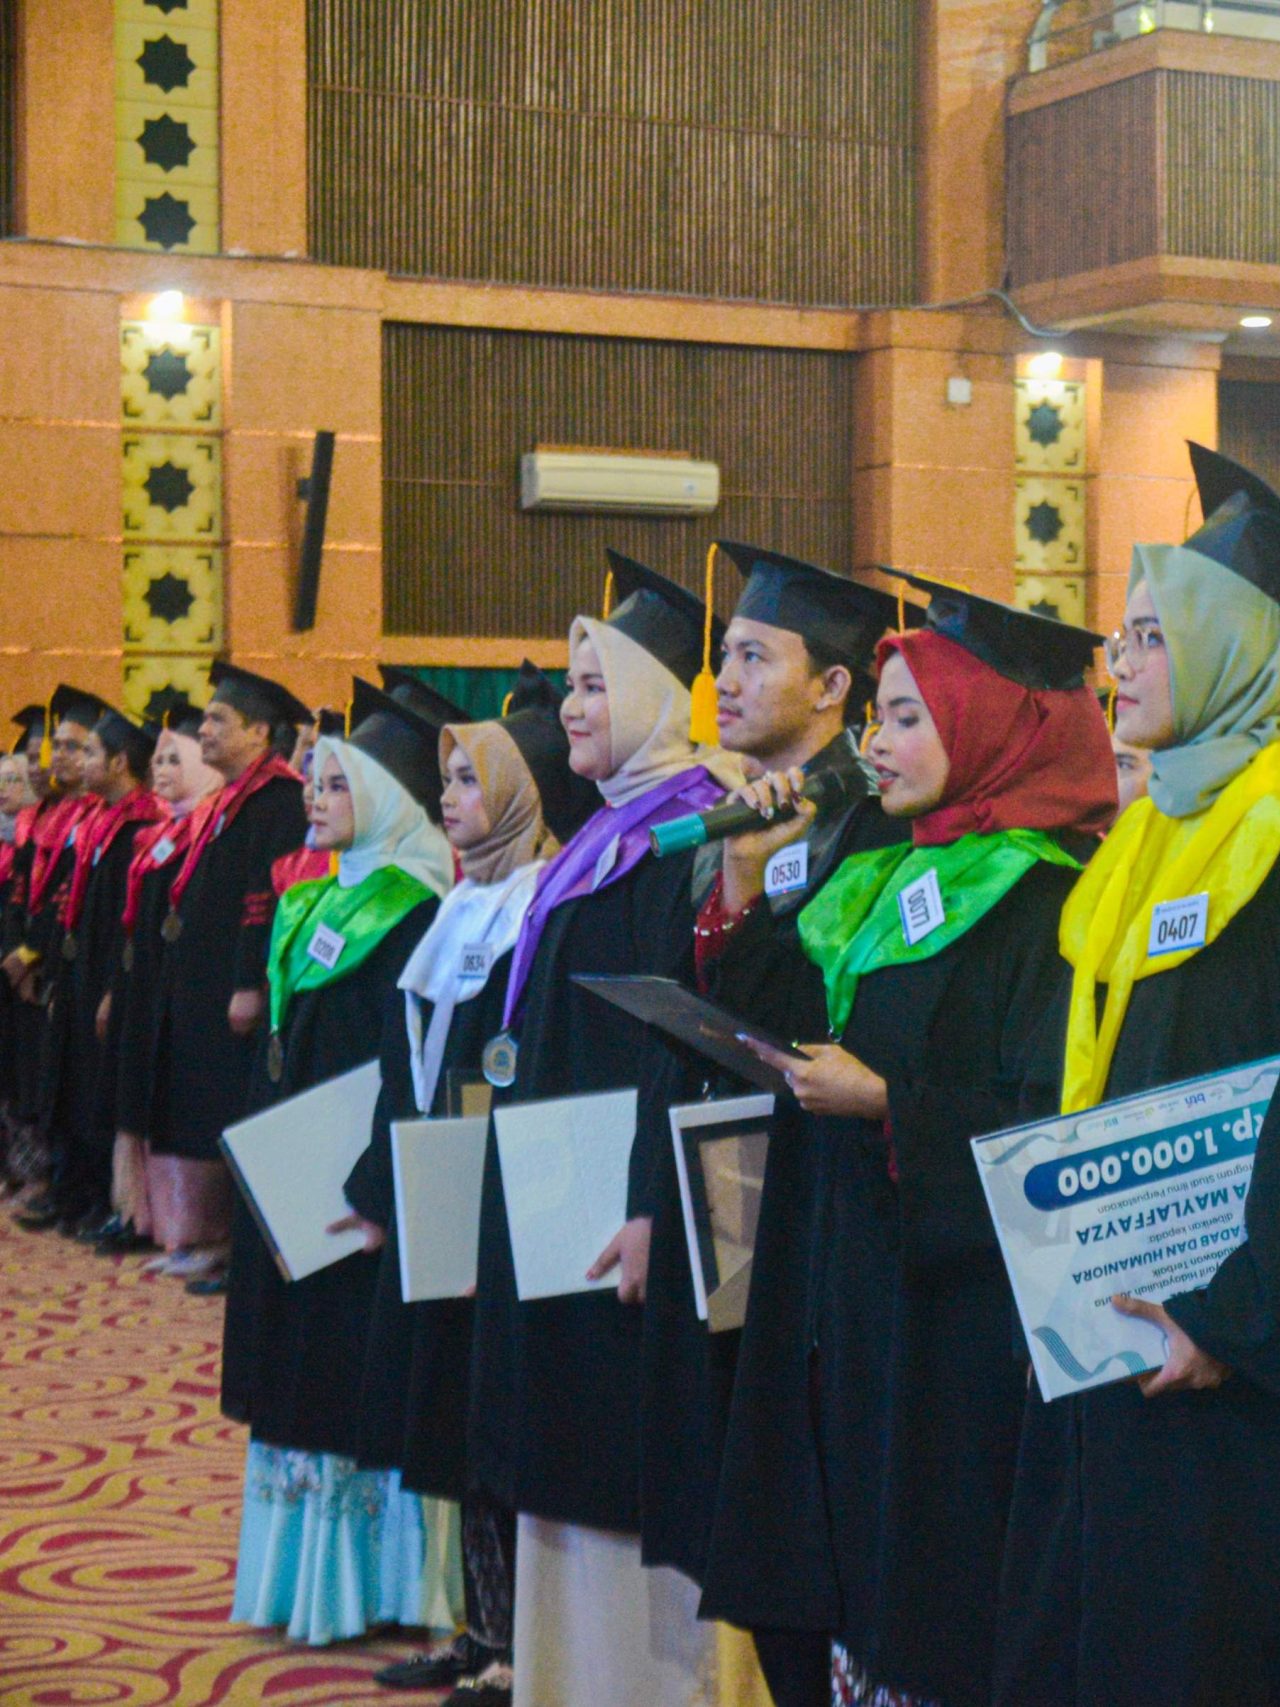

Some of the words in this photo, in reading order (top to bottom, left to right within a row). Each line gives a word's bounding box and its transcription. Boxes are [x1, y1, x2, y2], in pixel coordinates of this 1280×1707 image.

[771, 859, 800, 886] 0530
[1158, 913, 1198, 944] 0407
[1058, 1128, 1218, 1196] 1.000.000
[1216, 1163, 1253, 1180] rogram
[1190, 1174, 1215, 1188] Studi
[1097, 1188, 1165, 1215] Perpustakaan
[1076, 1186, 1228, 1245] MAYLAFFAYZA
[1188, 1212, 1233, 1231] diberikan
[1166, 1239, 1197, 1256] DAN
[1200, 1225, 1241, 1247] ADAB
[1072, 1248, 1163, 1285] HUMANIORA
[1152, 1261, 1188, 1277] Terbaik
[1134, 1271, 1197, 1295] Hidayatullah
